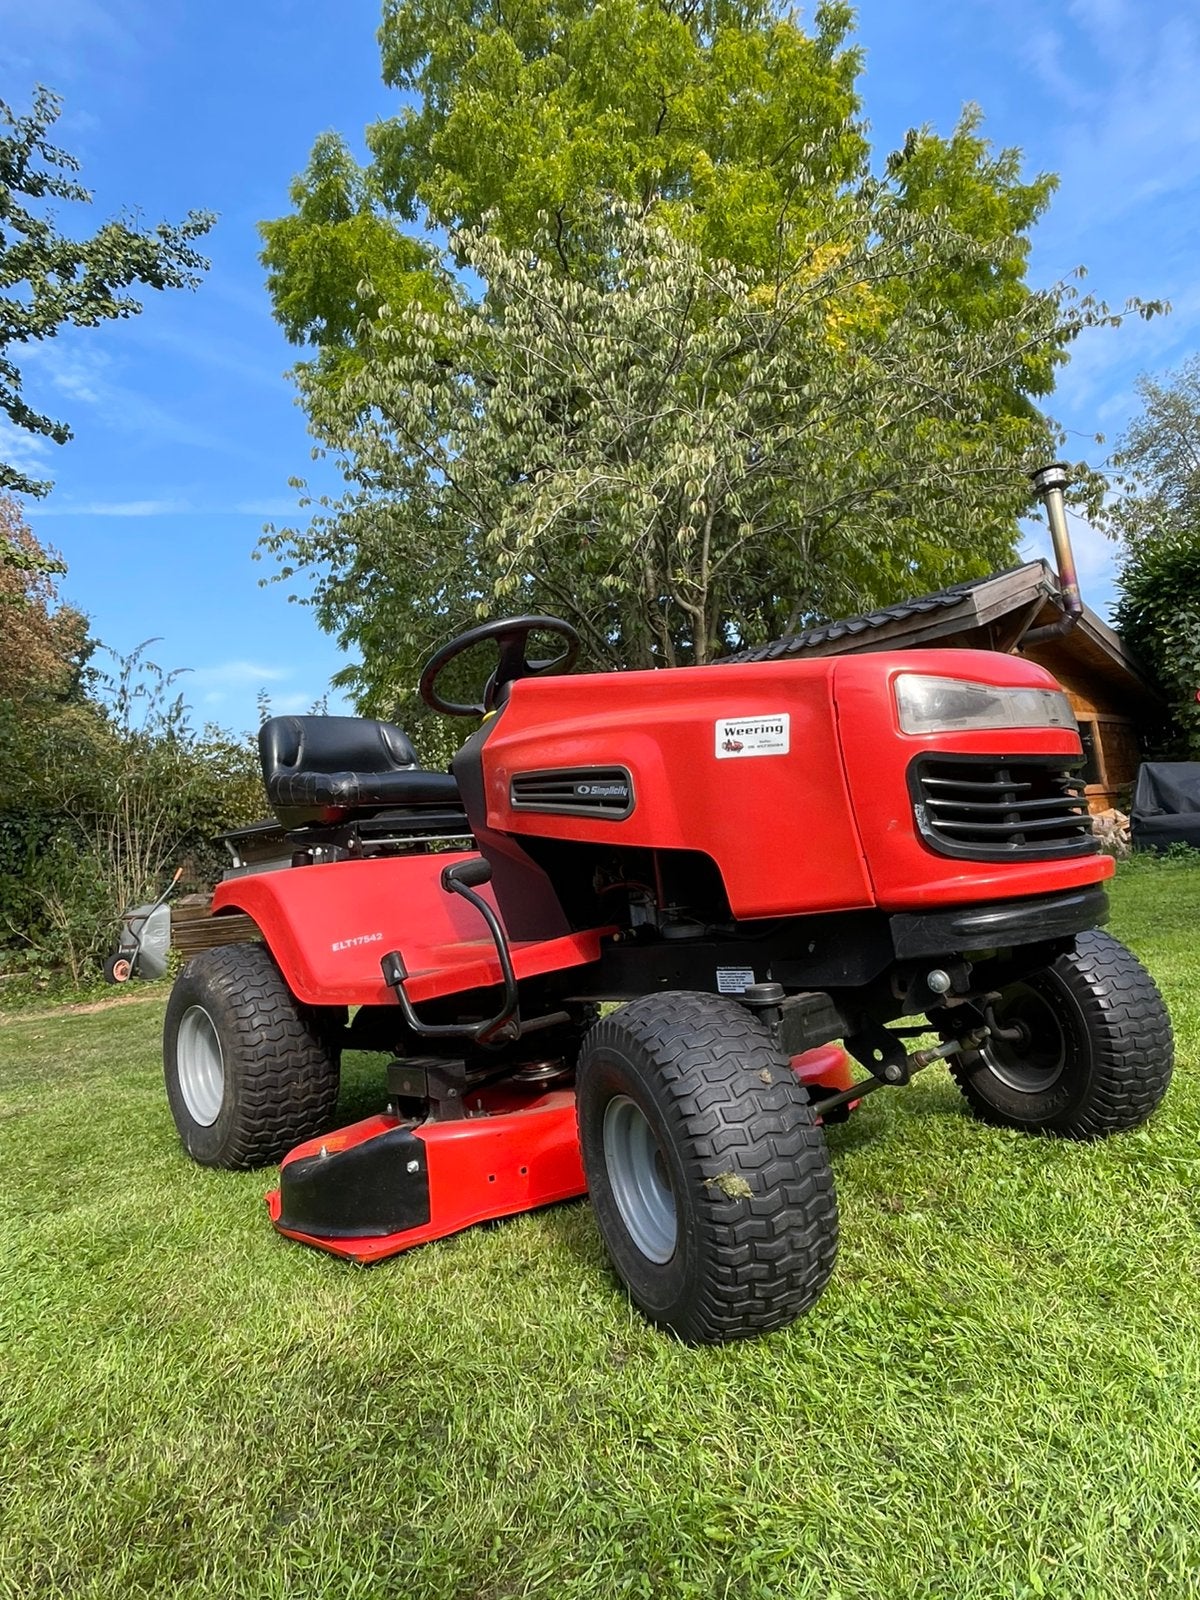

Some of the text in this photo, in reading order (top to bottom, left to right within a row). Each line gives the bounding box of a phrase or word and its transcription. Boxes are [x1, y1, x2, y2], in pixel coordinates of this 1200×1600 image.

[724, 724, 783, 736] Weering
[590, 785, 629, 796] Simplicity
[332, 932, 383, 952] ELT17542
